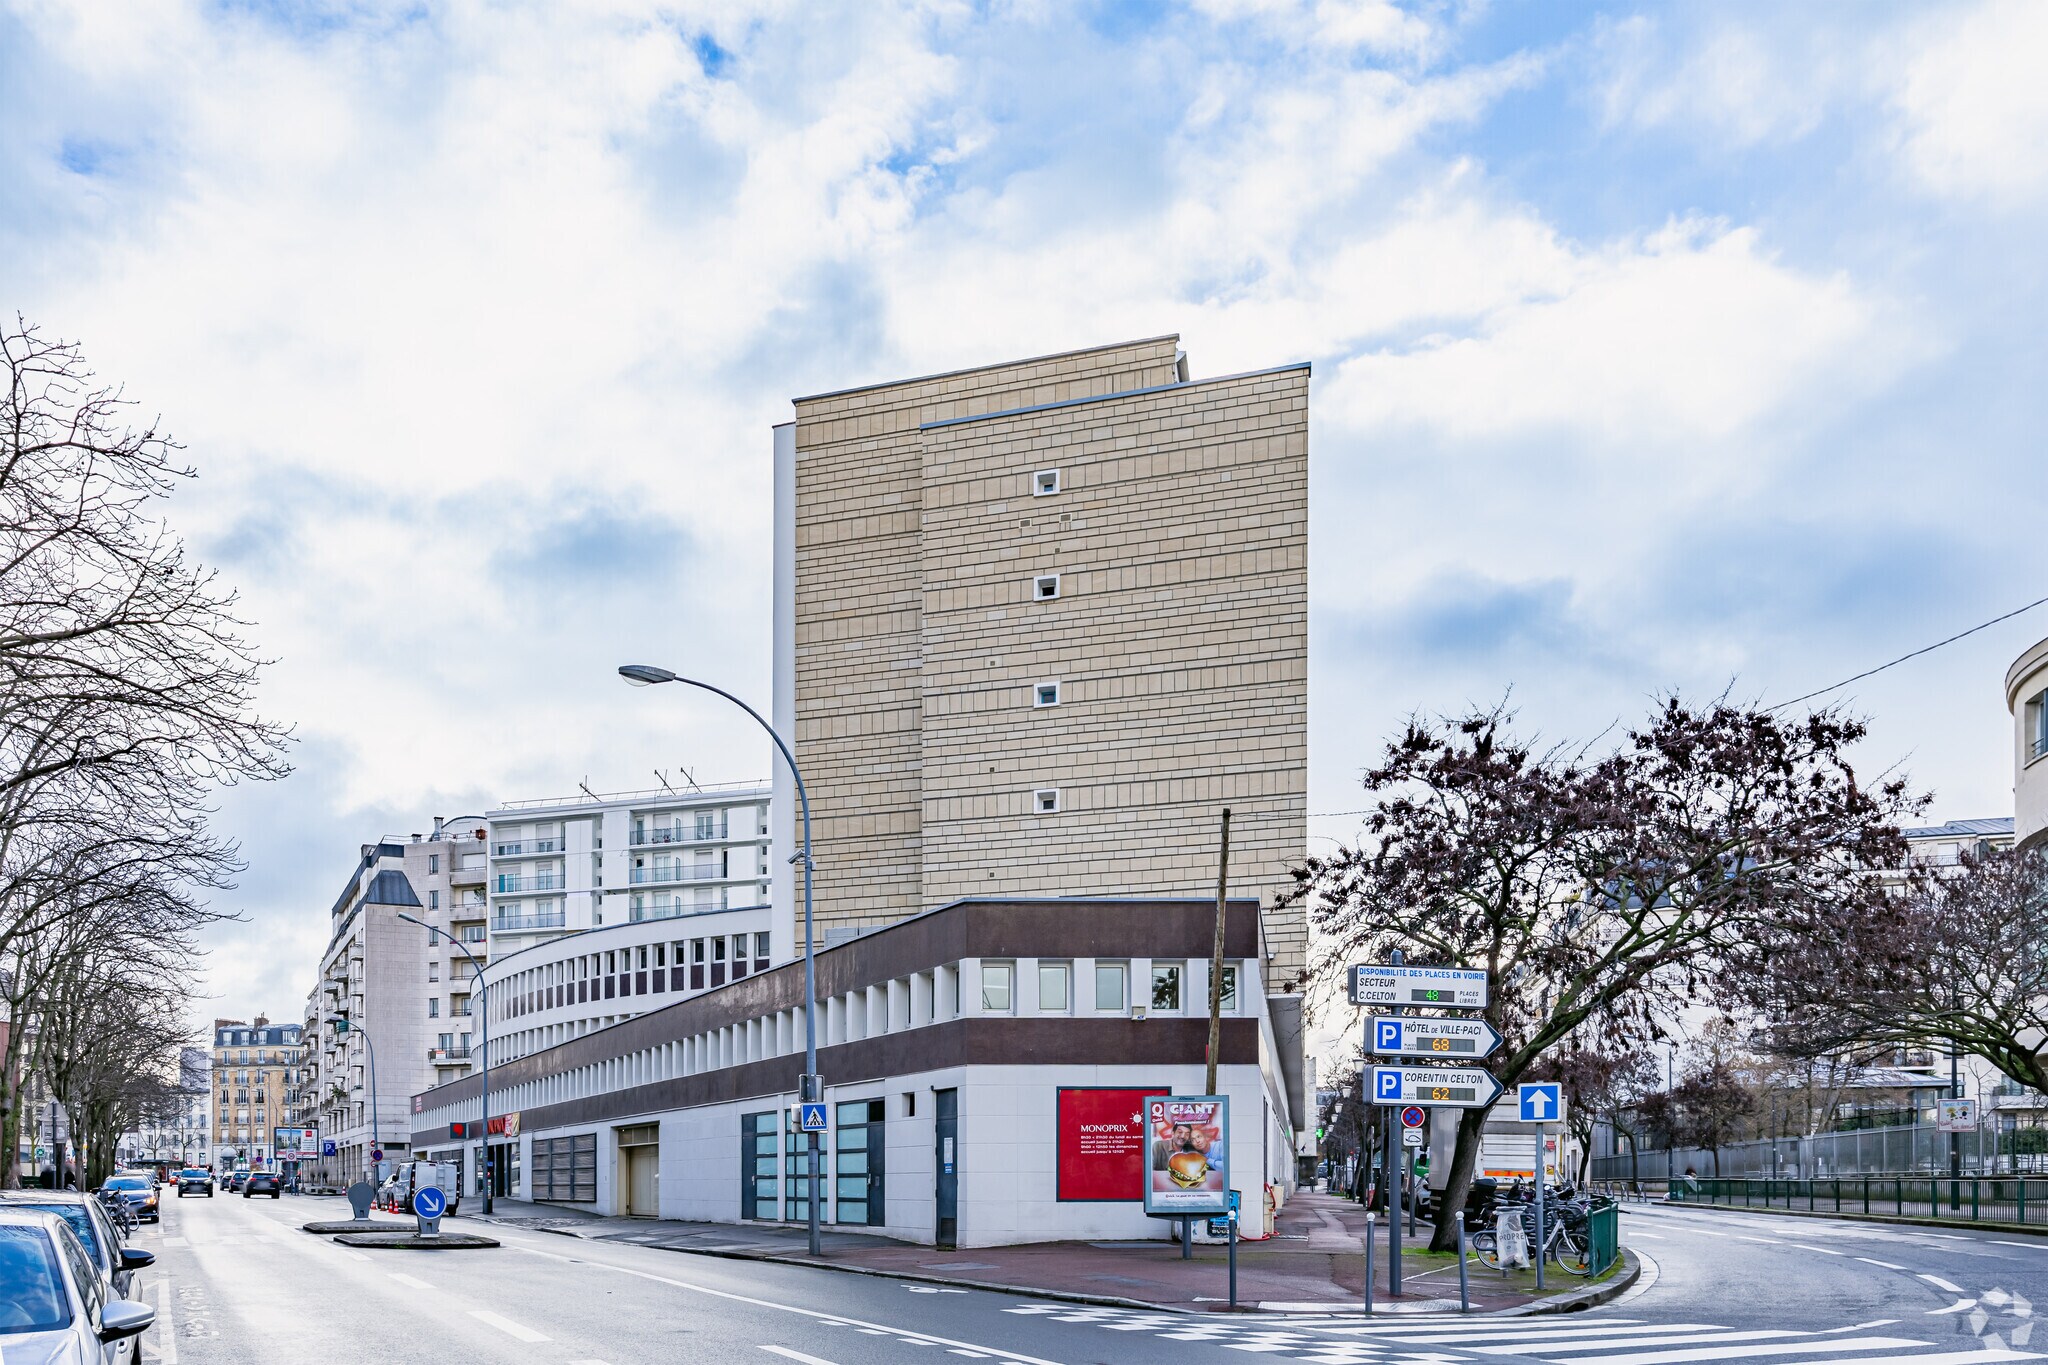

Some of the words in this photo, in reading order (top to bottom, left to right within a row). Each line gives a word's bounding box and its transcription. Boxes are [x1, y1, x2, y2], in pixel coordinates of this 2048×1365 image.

[1359, 968, 1407, 977] DISPONIBILITÉ
[1425, 970, 1451, 979] PLACES
[1464, 972, 1485, 980] VOIRIE
[1359, 978, 1396, 988] SECTEUR
[1359, 991, 1396, 1000] C.CELTON
[1426, 990, 1439, 1001] 48
[1404, 1021, 1430, 1034] HÔTEL
[1382, 1025, 1396, 1046] P
[1432, 1038, 1450, 1051] 68
[1404, 1072, 1448, 1083] CORENTIN
[1450, 1074, 1484, 1084] CELTON
[1382, 1074, 1396, 1096] P
[1432, 1088, 1450, 1100] 62
[1080, 1124, 1128, 1132] MONOPRIX
